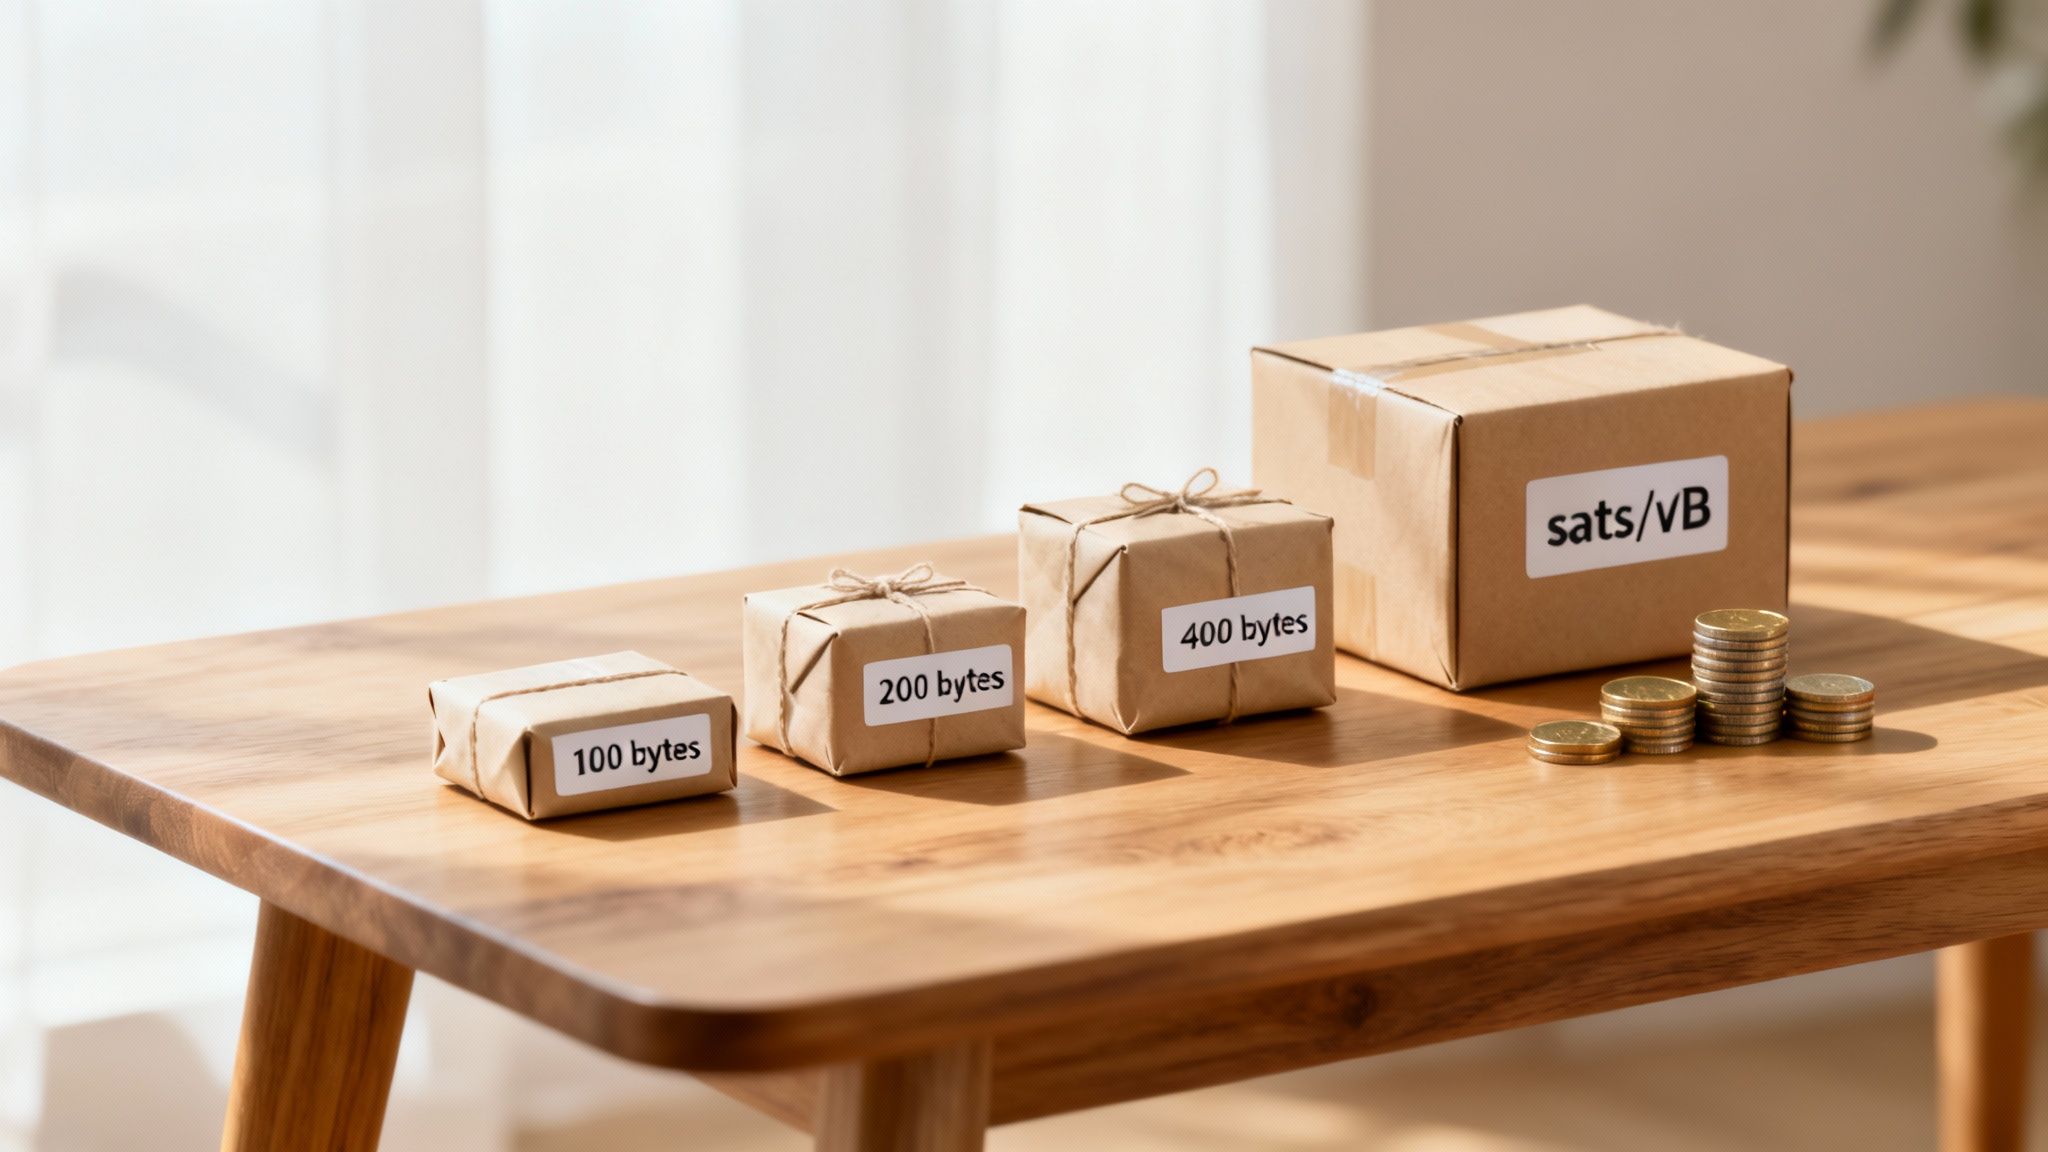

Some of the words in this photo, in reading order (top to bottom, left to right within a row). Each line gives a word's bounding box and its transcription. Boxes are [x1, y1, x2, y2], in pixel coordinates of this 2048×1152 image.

[1547, 485, 1712, 548] sats/vB
[1180, 618, 1233, 650] 400
[1241, 612, 1309, 647] bytes
[879, 674, 929, 706] 200
[937, 668, 1005, 703] bytes
[574, 743, 623, 776] 100
[630, 738, 702, 773] bytes
